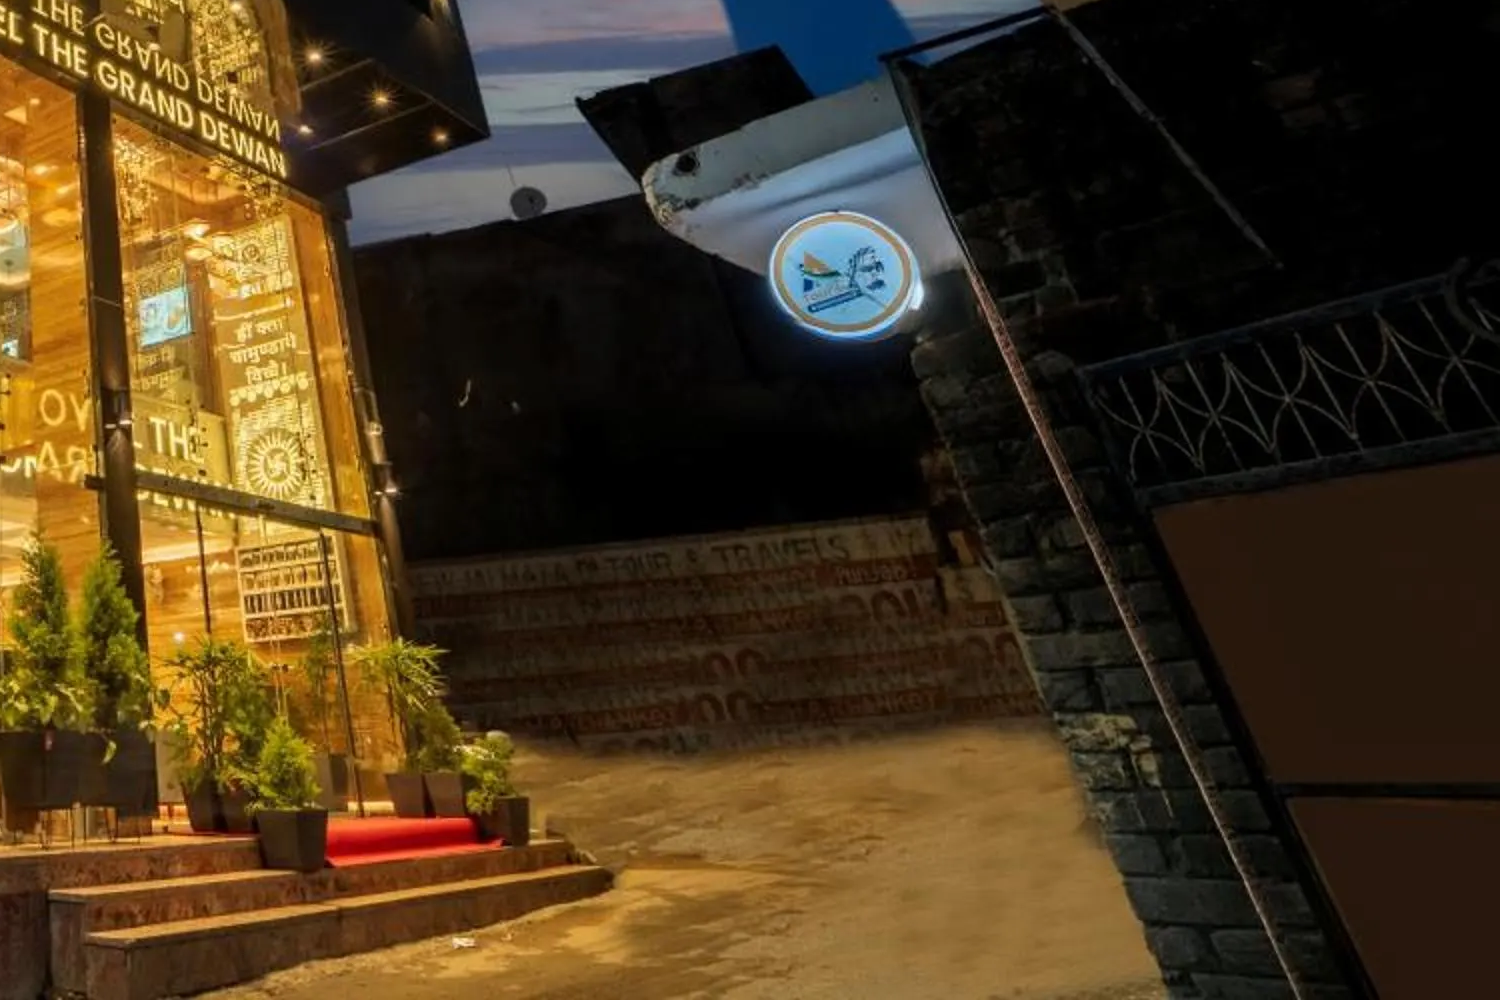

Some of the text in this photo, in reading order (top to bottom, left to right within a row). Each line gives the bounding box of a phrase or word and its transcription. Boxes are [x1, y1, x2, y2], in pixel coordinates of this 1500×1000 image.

[32, 23, 89, 77] THE
[97, 60, 194, 130] GRAND
[200, 111, 287, 178] DEWAN
[711, 533, 850, 571] TRAVELS
